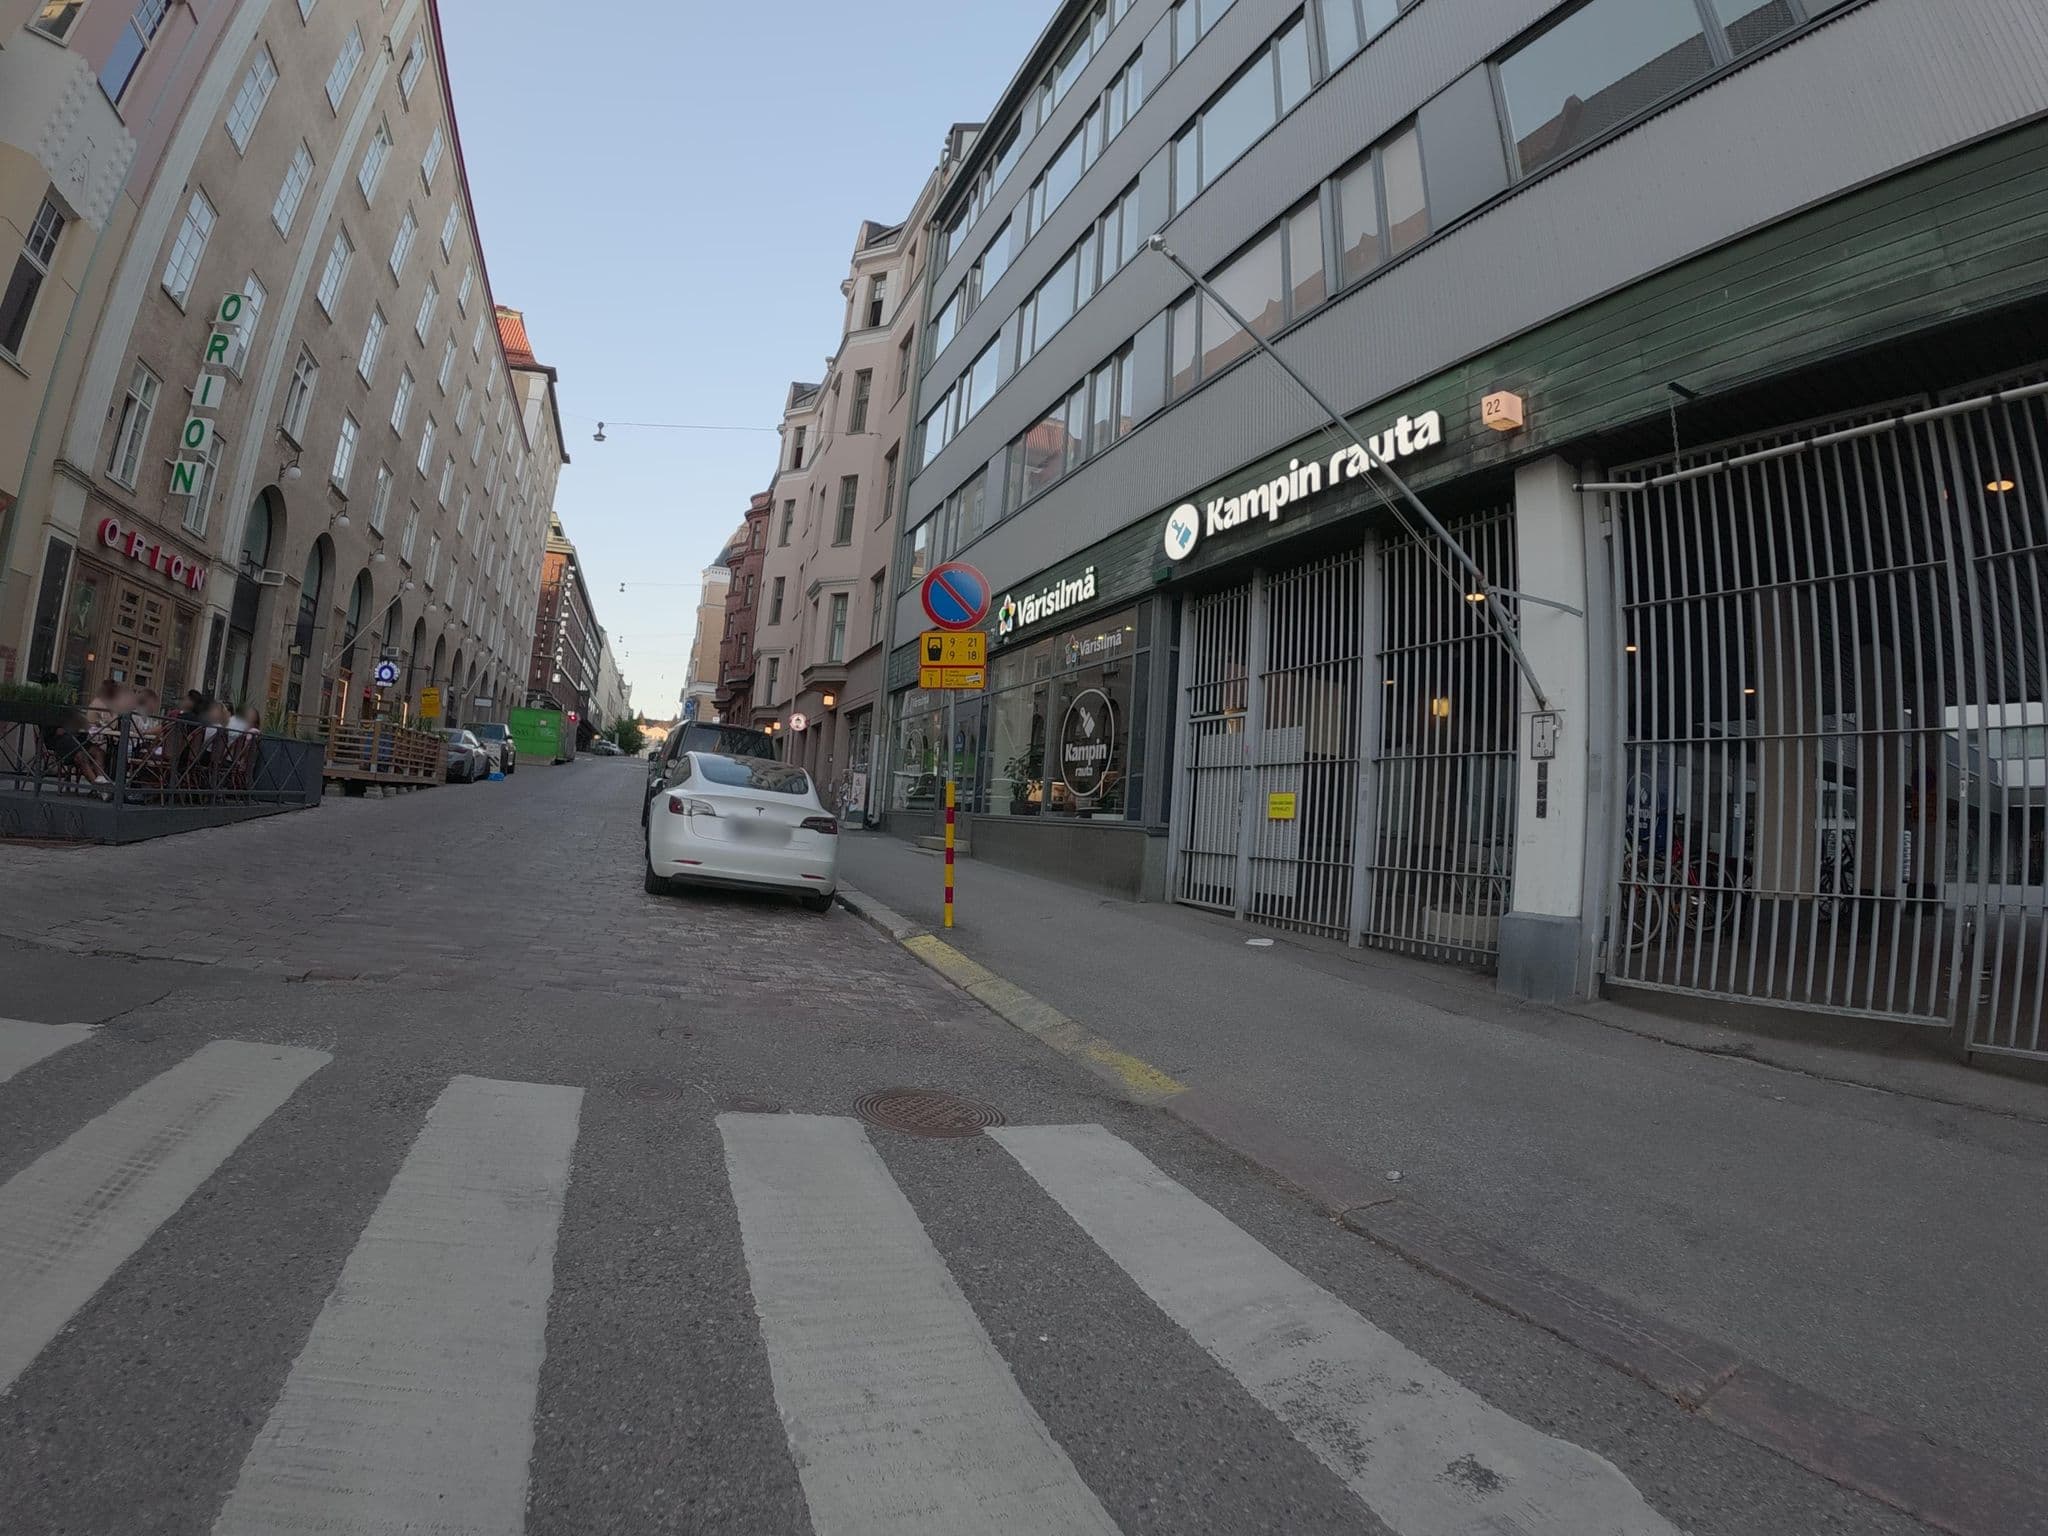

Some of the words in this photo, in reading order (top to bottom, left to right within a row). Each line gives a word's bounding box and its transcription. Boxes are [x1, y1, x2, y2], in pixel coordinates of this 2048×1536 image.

[172, 294, 242, 494] ORION
[1486, 399, 1501, 416] 22
[1206, 458, 1322, 537] Kampin
[1328, 409, 1442, 486] rauta
[98, 517, 206, 592] ORION
[1017, 566, 1095, 627] Värisilmä
[949, 637, 956, 647] 9
[967, 637, 977, 648] 21
[1079, 629, 1122, 656] Värisilmä
[1065, 738, 1107, 766] Kampin
